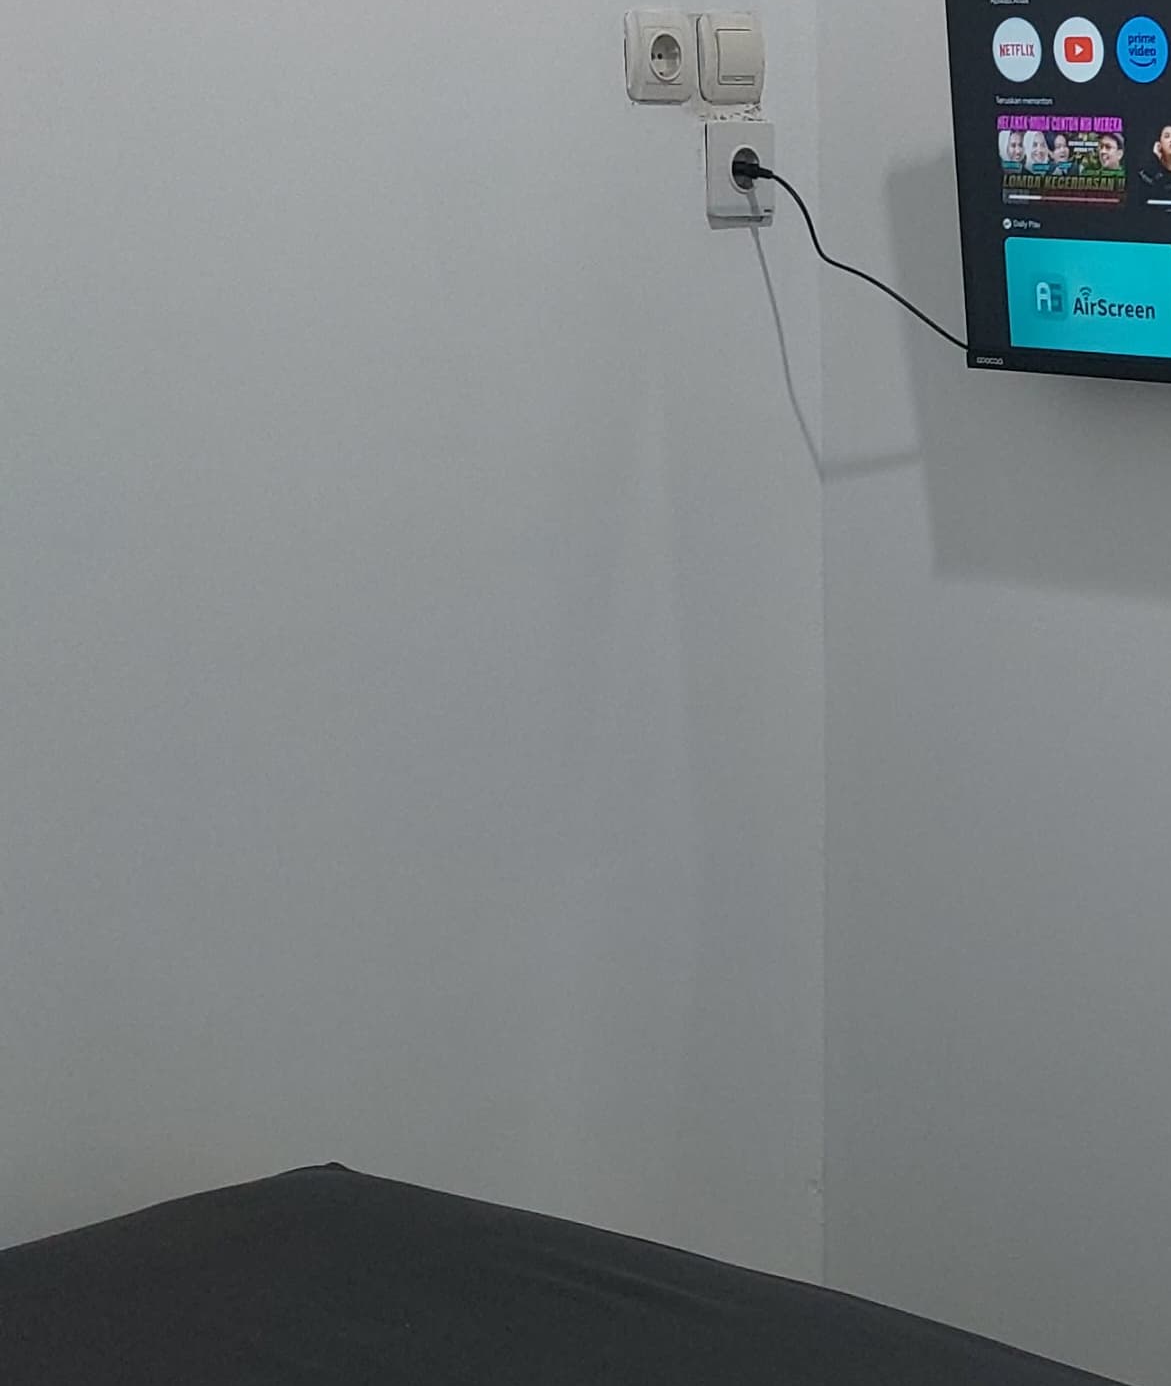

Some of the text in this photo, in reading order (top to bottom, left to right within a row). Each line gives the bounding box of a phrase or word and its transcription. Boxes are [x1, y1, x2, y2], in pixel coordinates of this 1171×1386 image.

[1128, 32, 1155, 46] prime
[1000, 43, 1035, 58] NETFLIX
[1128, 45, 1156, 57] video
[1073, 295, 1156, 320] AirScreen
